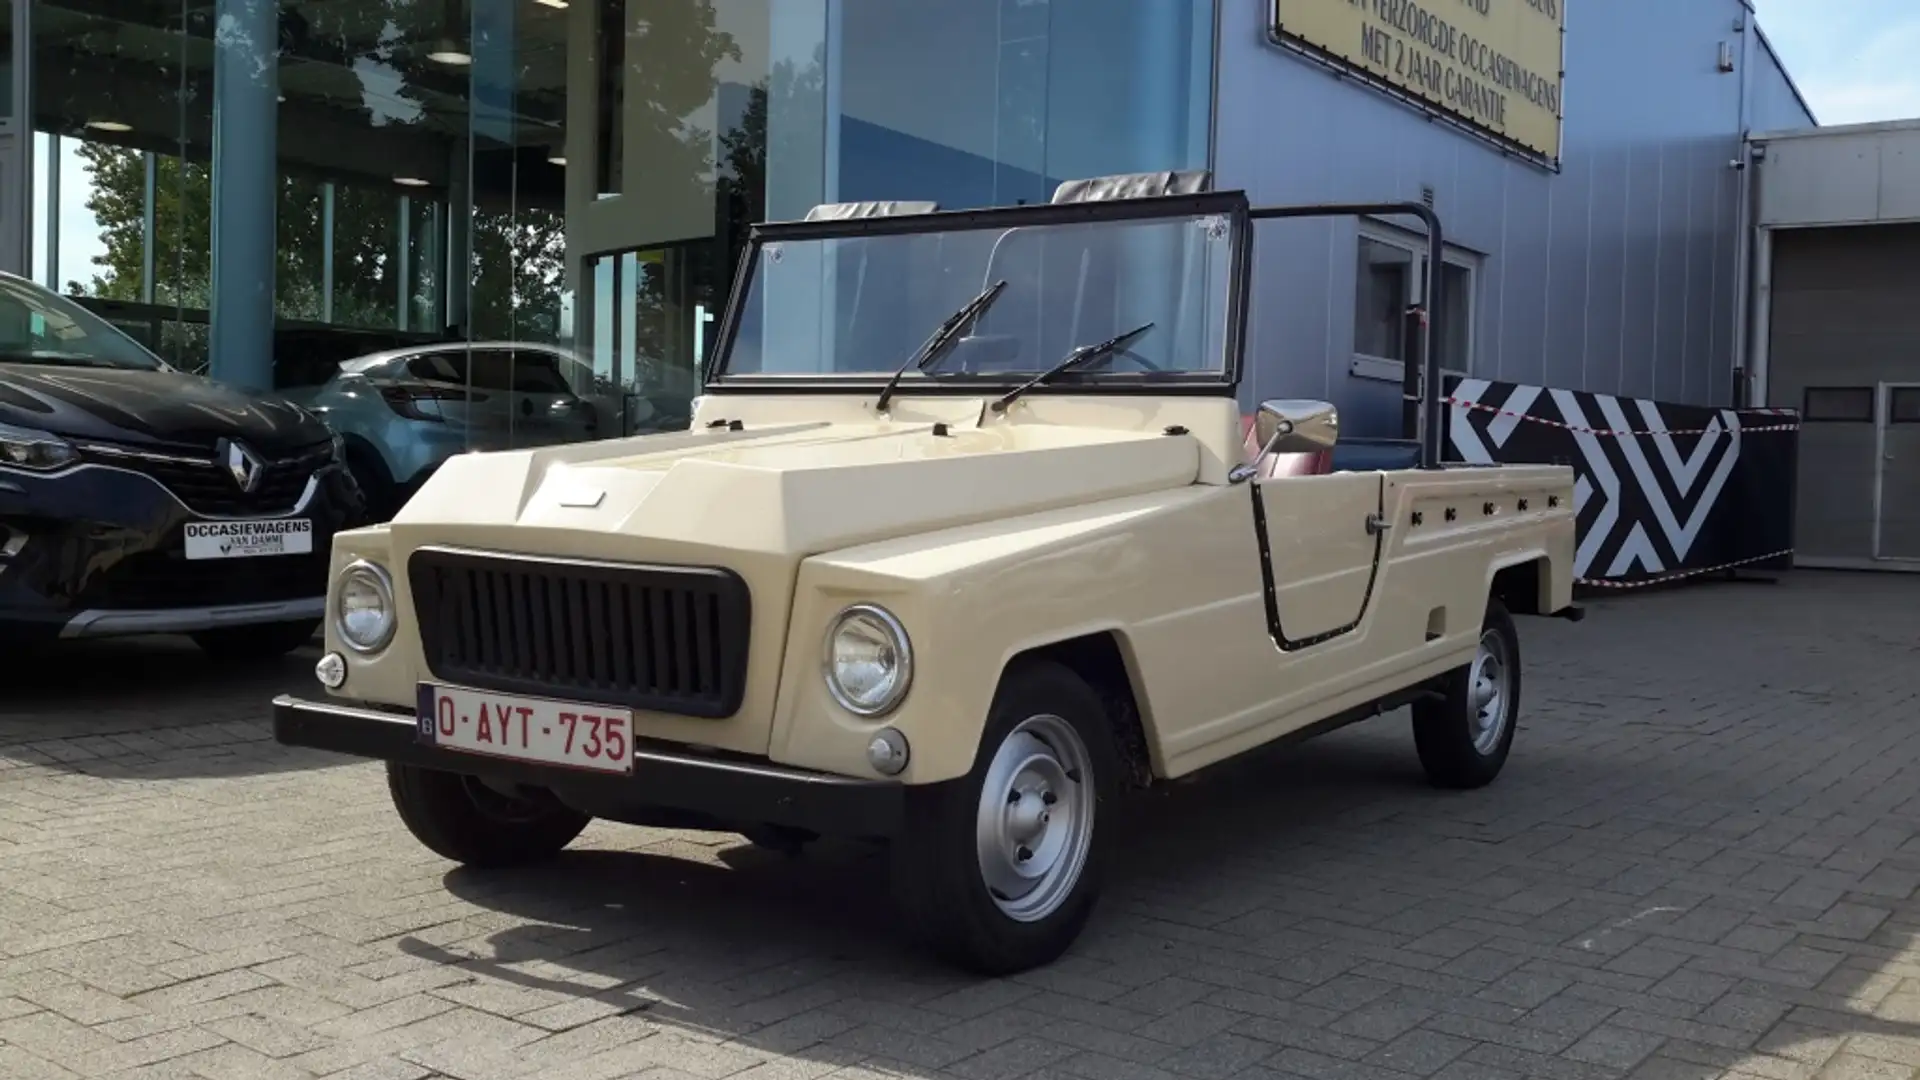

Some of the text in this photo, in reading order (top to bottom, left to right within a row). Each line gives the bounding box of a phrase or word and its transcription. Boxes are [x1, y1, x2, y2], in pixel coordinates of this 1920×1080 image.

[1361, 20, 1506, 125] MET 2 JAAR GARANTIE
[1459, 32, 1556, 112] OCCASIEWAGENS
[186, 521, 310, 538] OCCASIEWAGENS
